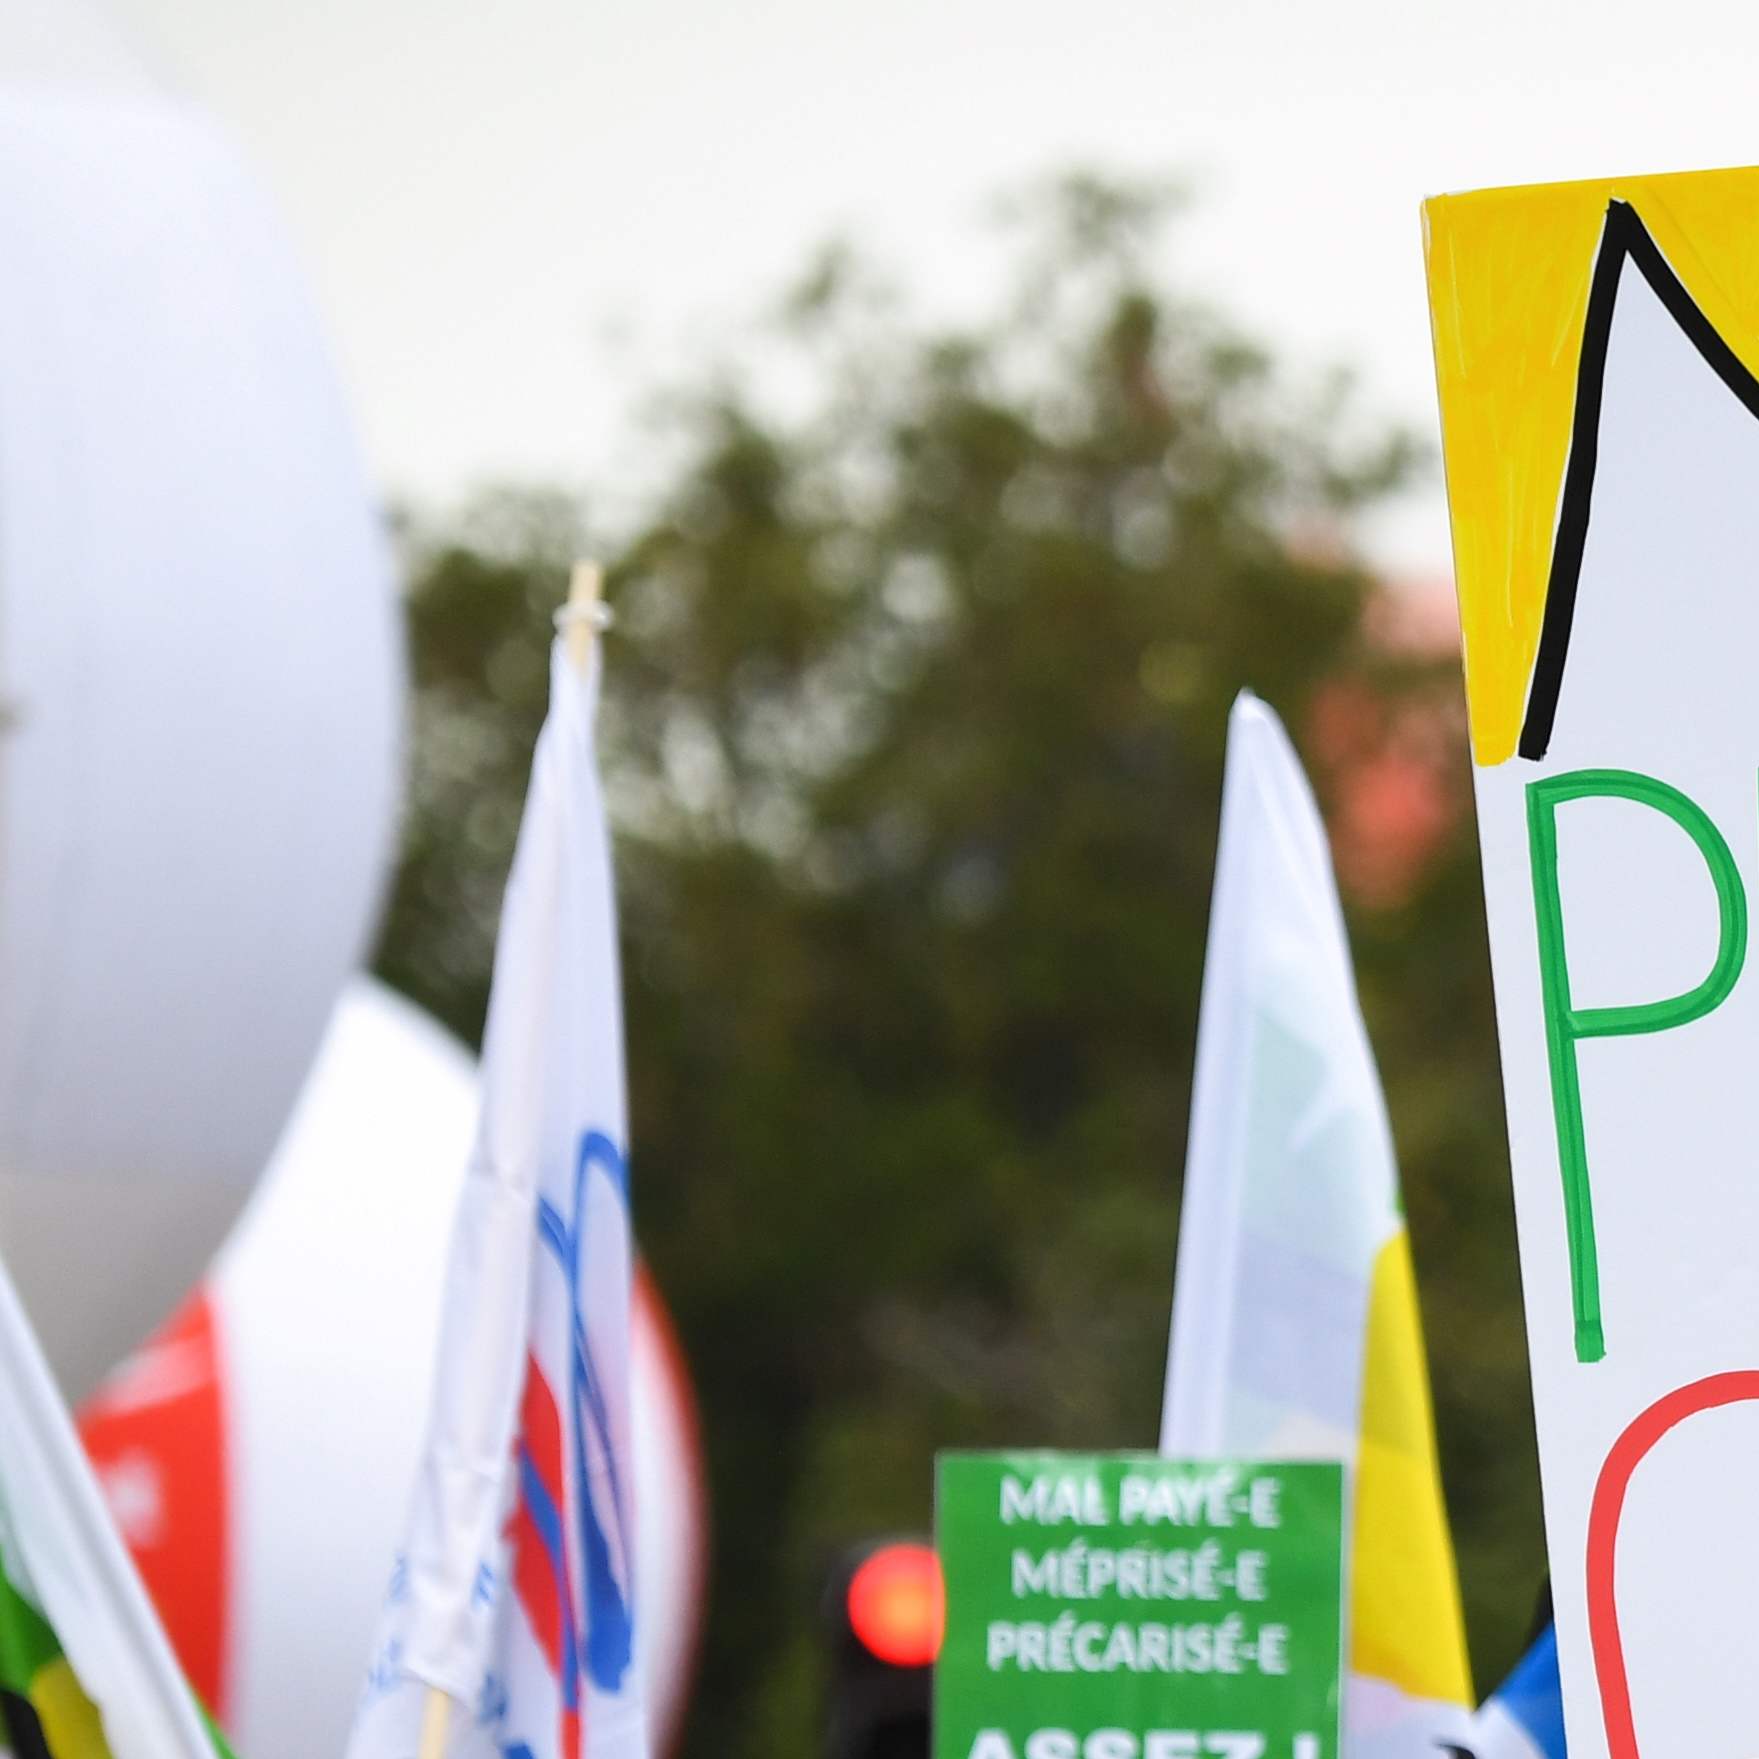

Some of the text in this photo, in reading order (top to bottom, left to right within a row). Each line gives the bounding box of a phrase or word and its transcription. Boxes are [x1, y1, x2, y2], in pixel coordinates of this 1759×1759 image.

[1000, 1464, 1281, 1528] MAL PAYÉ-E
[1011, 1537, 1268, 1601] MÉPRISÉ-E
[986, 1609, 1290, 1675] PRÉCARISÉ-E
